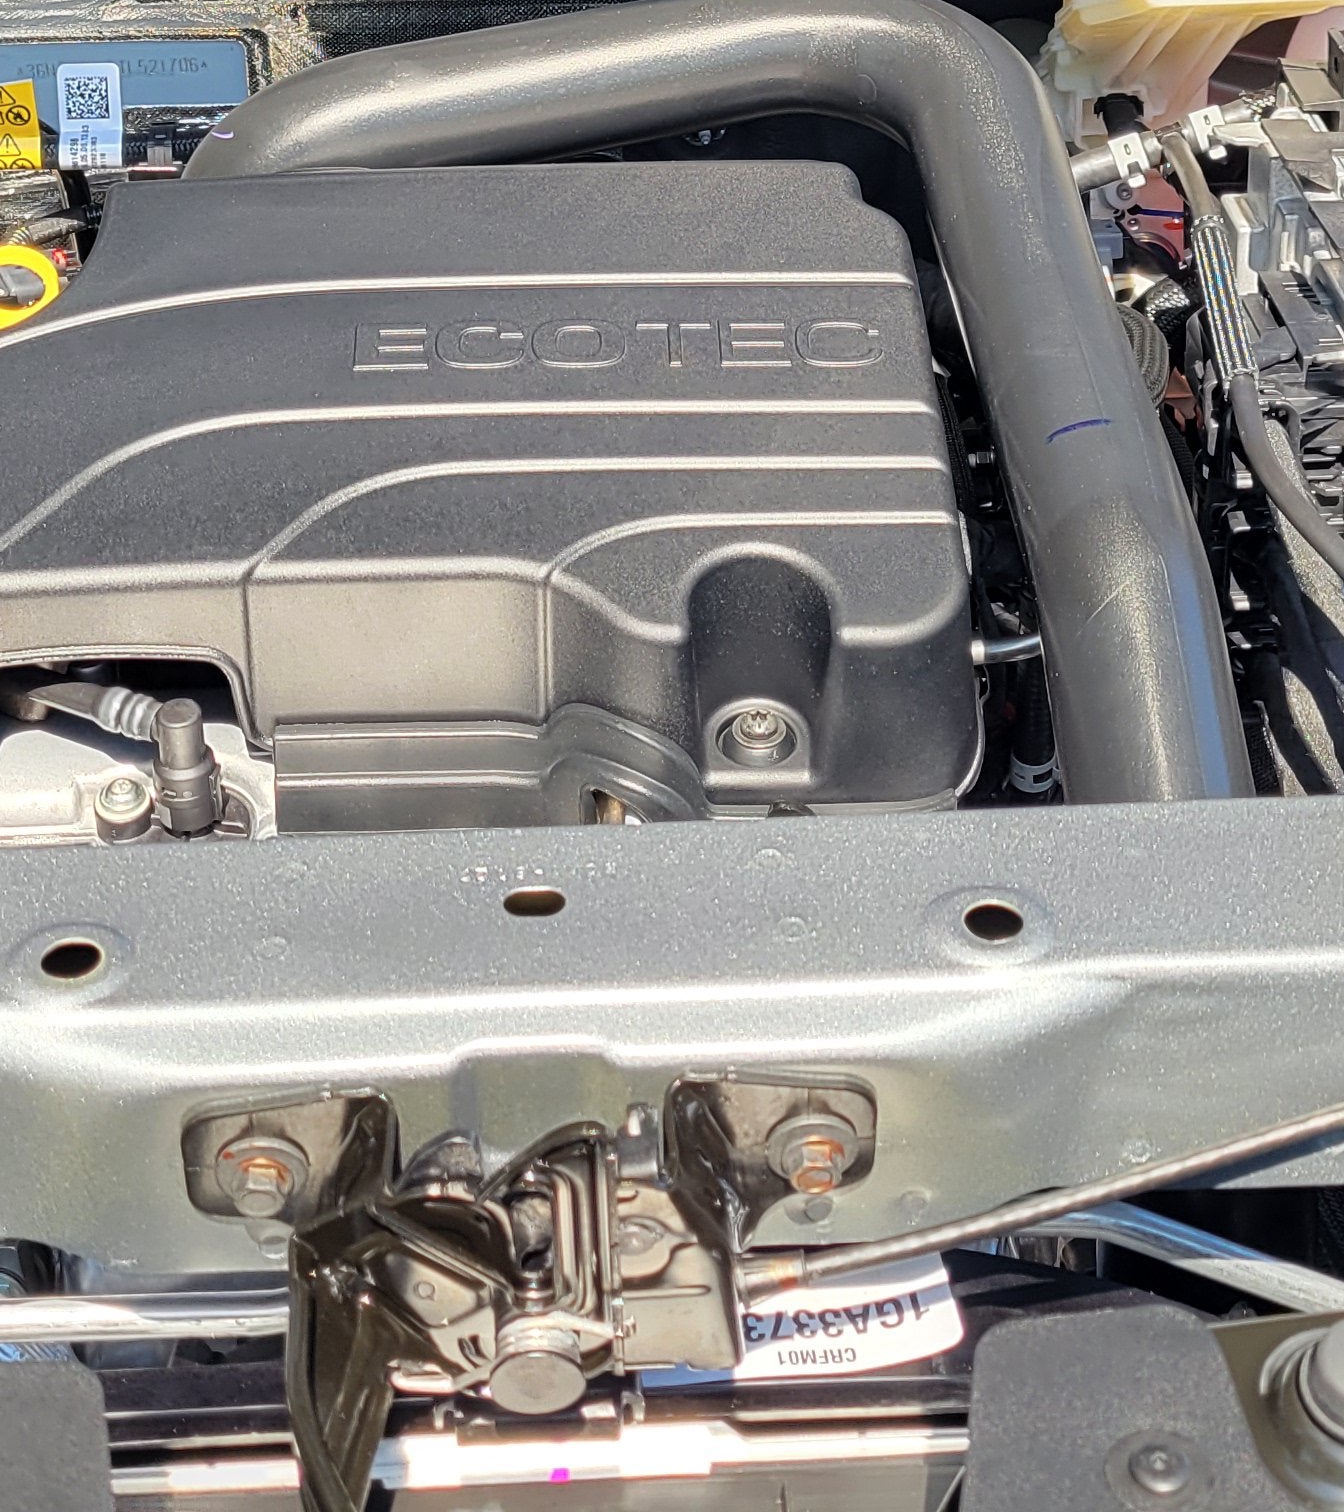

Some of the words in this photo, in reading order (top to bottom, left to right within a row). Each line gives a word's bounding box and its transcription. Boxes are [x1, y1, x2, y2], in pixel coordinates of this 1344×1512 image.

[353, 320, 884, 371] ECOTEC
[741, 1292, 930, 1343] 1GA3373
[777, 1347, 857, 1366] CRFM01
